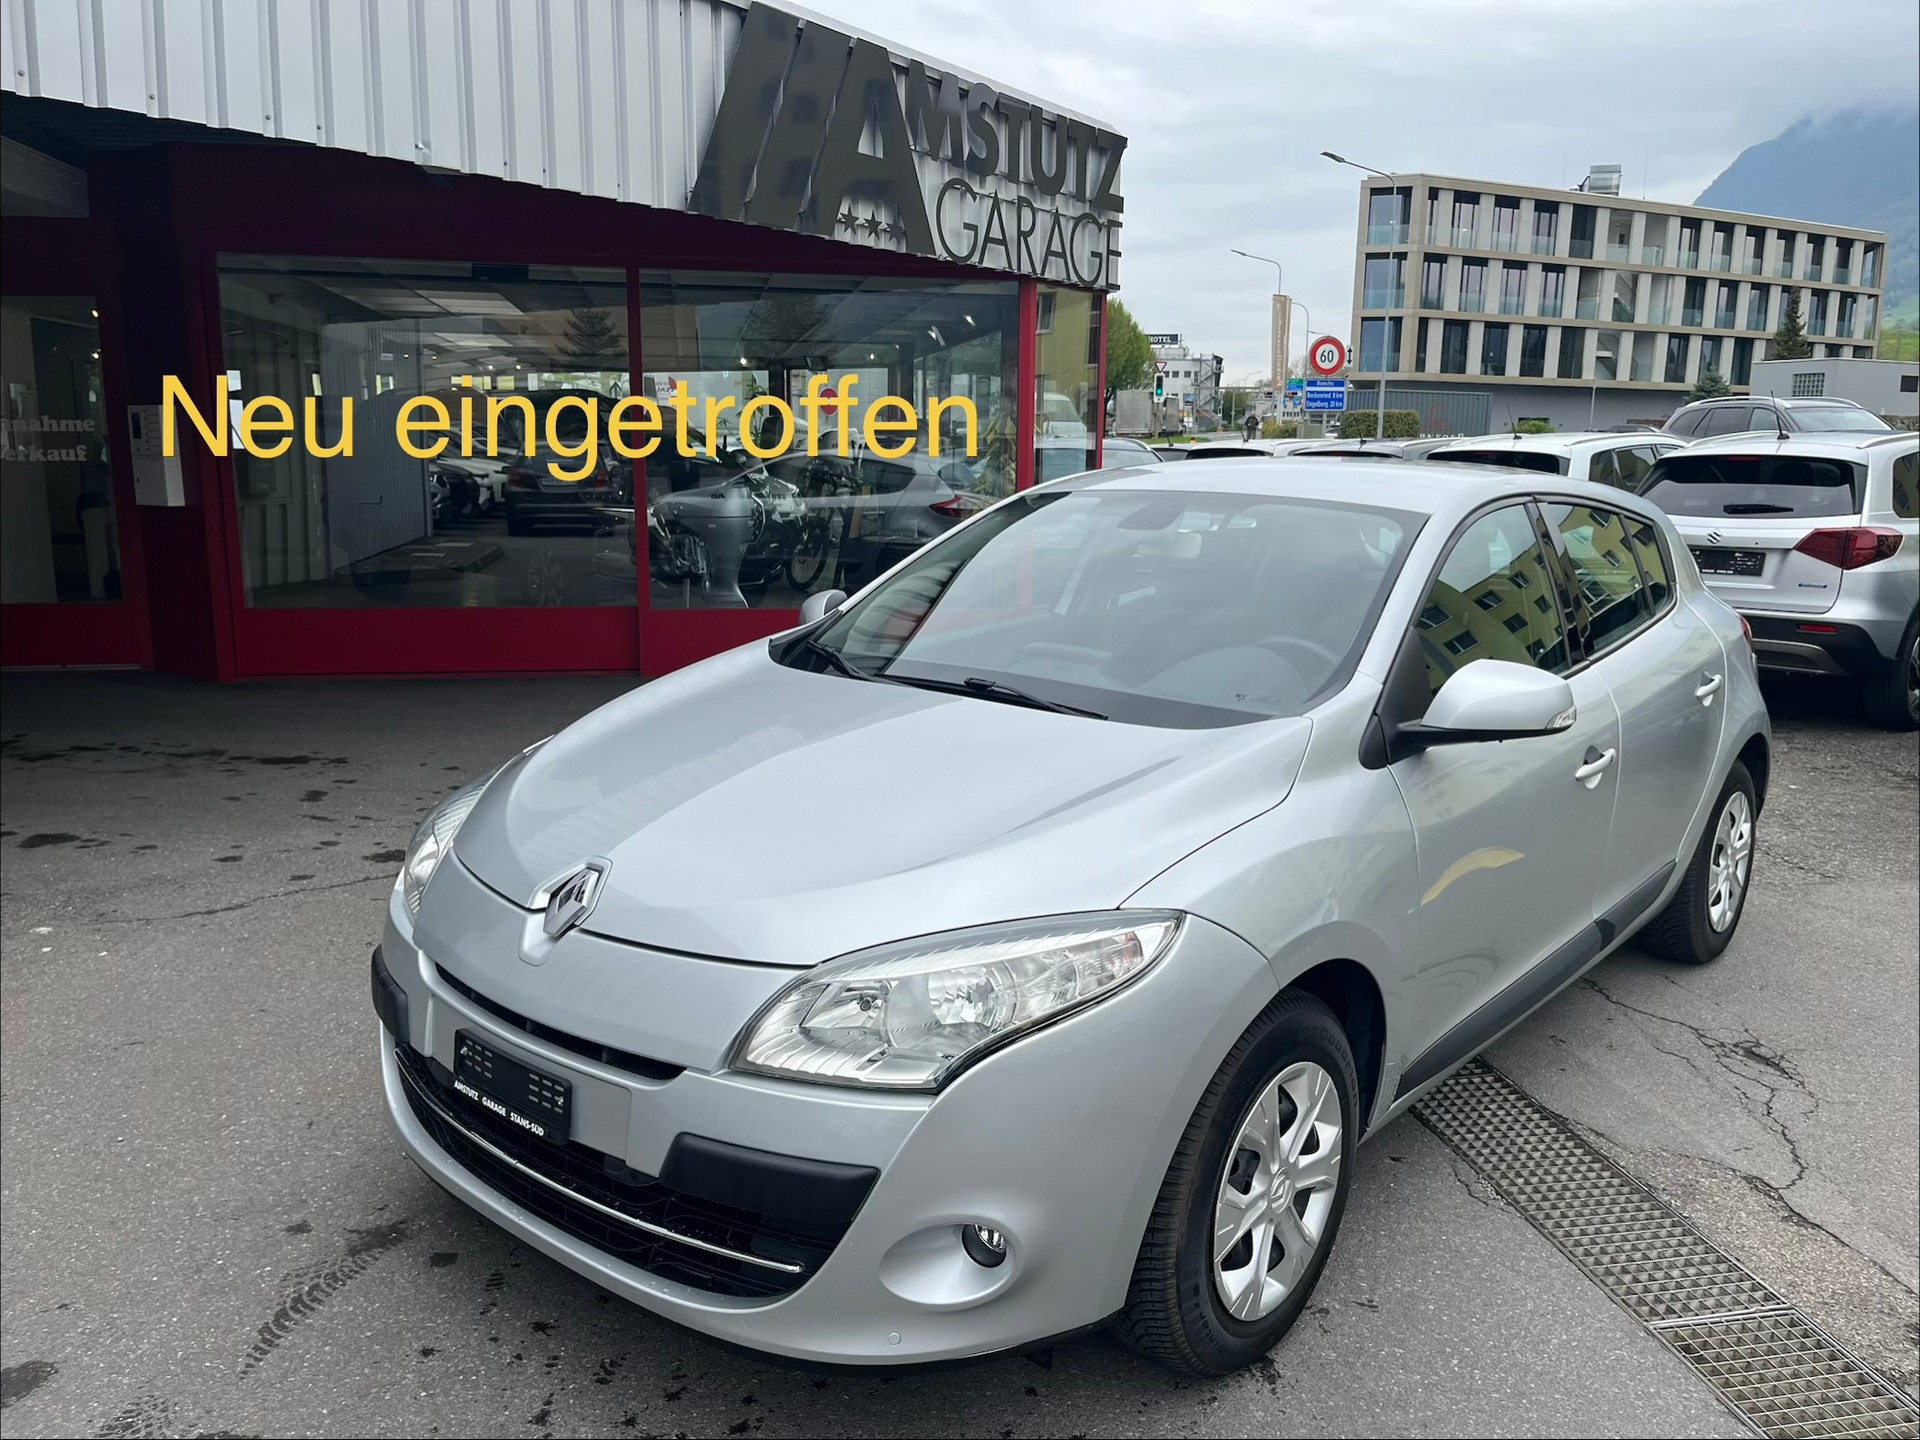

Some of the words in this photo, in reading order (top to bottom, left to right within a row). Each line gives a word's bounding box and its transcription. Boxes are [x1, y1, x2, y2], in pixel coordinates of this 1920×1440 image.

[790, 37, 1129, 256] AMSTUTZ
[936, 178, 1124, 291] GARAGE
[1320, 350, 1334, 363] 60
[453, 1080, 479, 1101] AMSTUTZ
[481, 1096, 506, 1117] GARAGE
